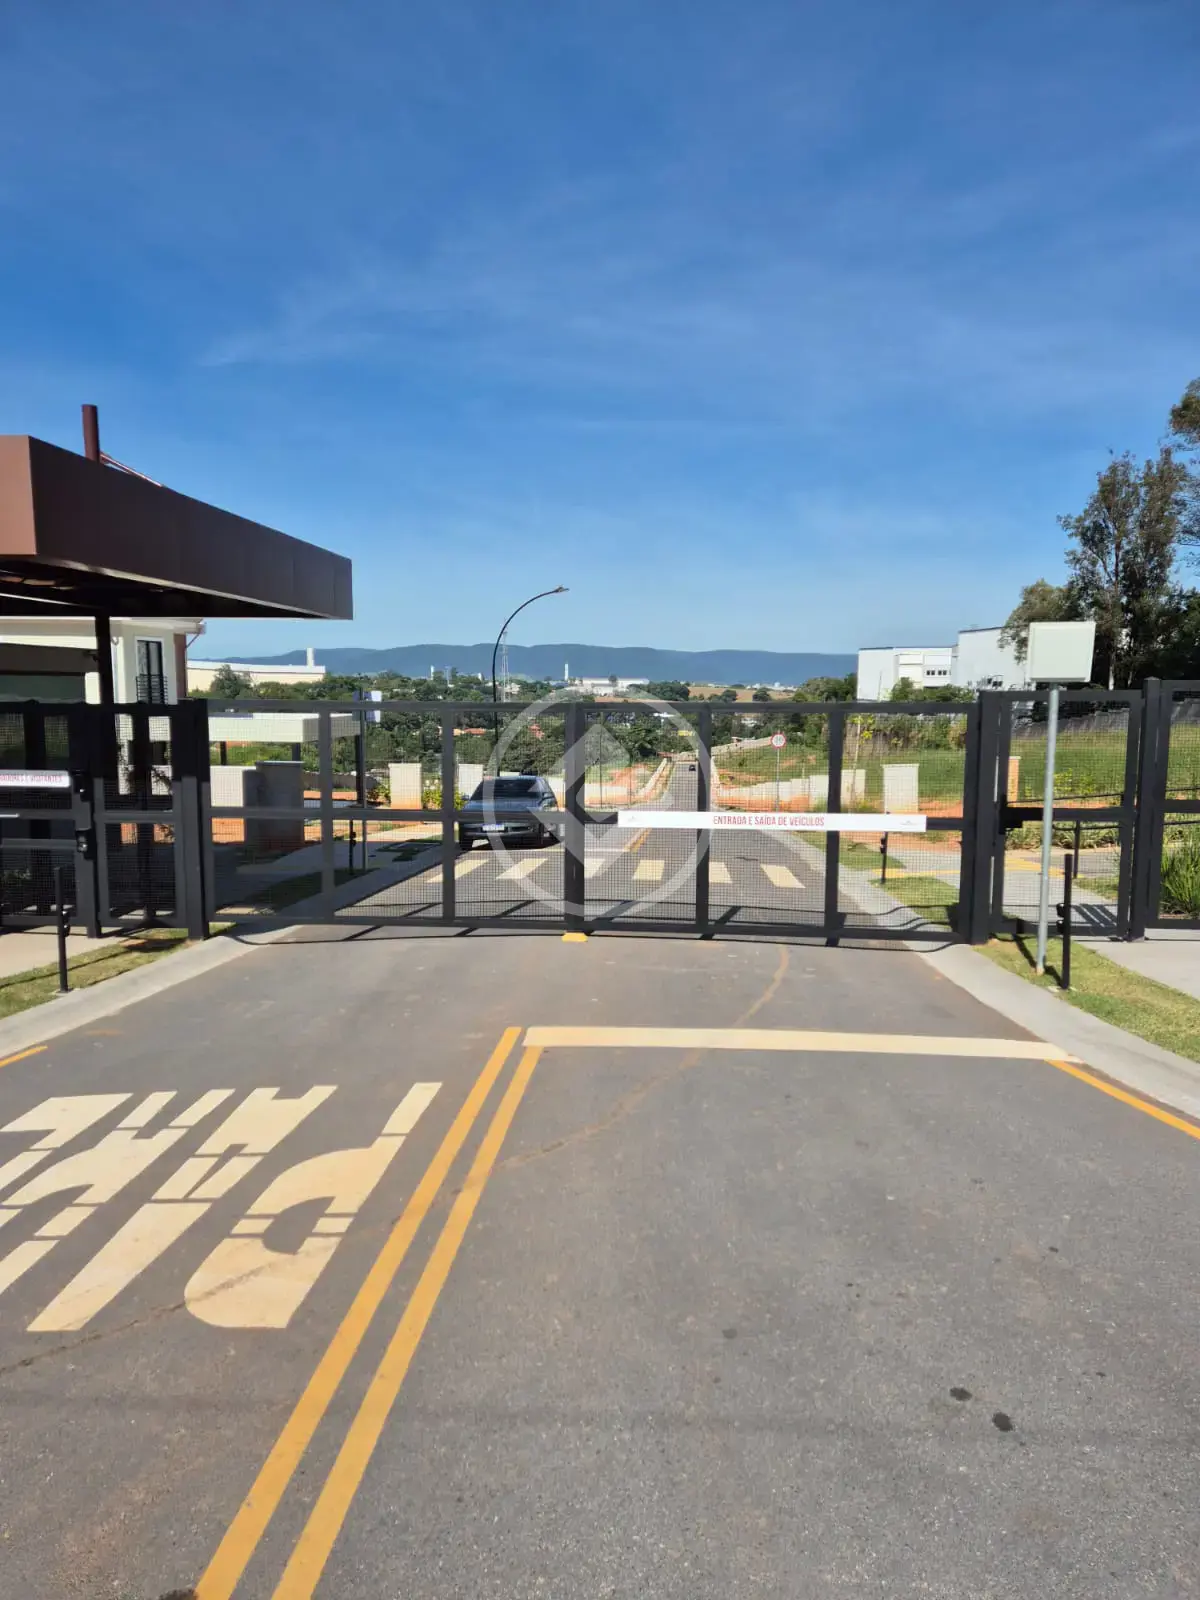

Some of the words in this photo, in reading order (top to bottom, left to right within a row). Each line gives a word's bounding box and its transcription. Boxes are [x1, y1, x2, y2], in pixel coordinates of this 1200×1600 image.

[713, 815, 747, 826] ENTRADA
[748, 816, 753, 826] E
[754, 814, 776, 826] SAÍDA
[778, 816, 788, 826] DE
[789, 815, 825, 827] VEÍCULOS
